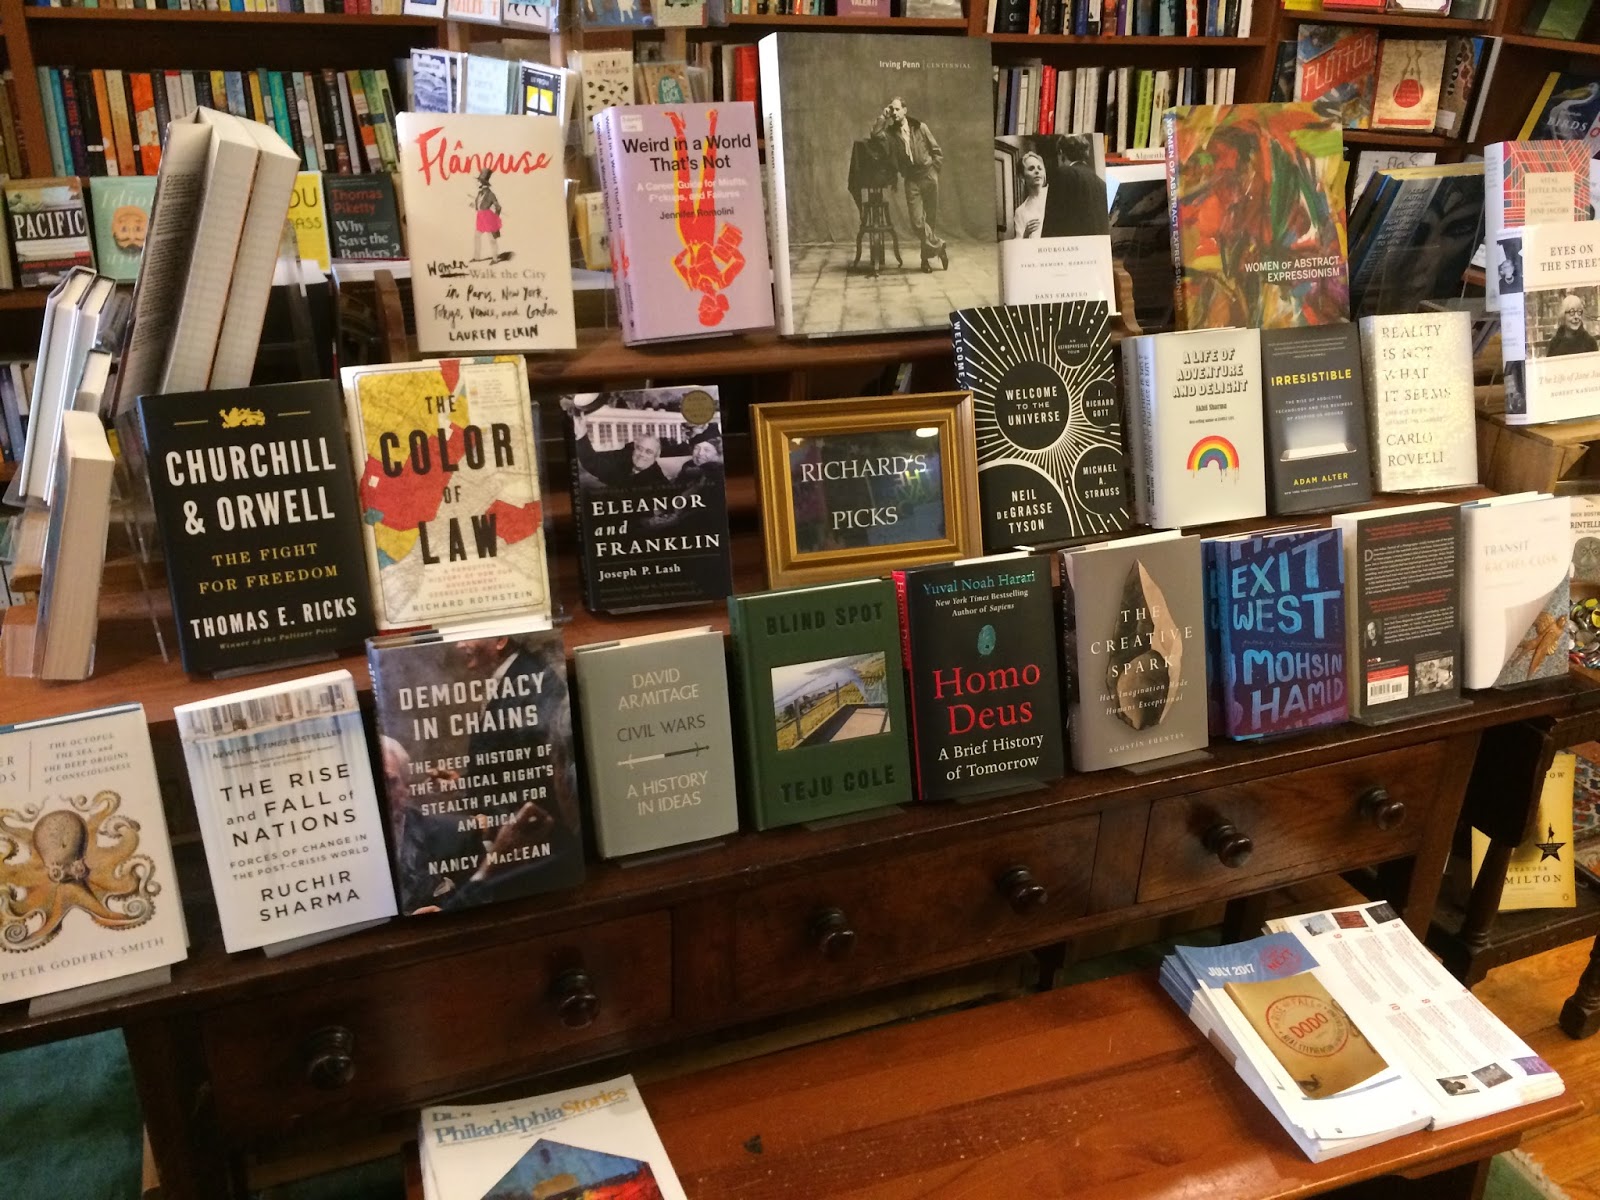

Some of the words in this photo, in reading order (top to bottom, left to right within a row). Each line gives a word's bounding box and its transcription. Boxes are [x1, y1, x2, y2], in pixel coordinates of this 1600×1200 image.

[879, 61, 900, 69] Irving
[903, 61, 920, 69] Penn
[662, 91, 680, 101] LUCK
[1547, 117, 1588, 131] BIRDS
[622, 138, 669, 153] Weird
[674, 137, 687, 150] in
[693, 141, 700, 150] a
[706, 134, 751, 149] World
[651, 157, 698, 172] That's
[703, 155, 731, 168] Not
[1169, 161, 1175, 175] OF
[332, 189, 383, 199] Thomas
[1169, 177, 1178, 228] ABSTRACT
[660, 211, 695, 219] Jennifer
[697, 207, 734, 216] Romolini
[13, 210, 85, 239] PACIFIC
[336, 221, 364, 235] Why
[339, 235, 367, 246] Save
[370, 233, 388, 244] the
[1551, 246, 1575, 256] EYES
[1580, 244, 1593, 254] ON
[1245, 259, 1279, 273] WOMEN
[1294, 256, 1340, 269] ABSTRACT
[1540, 261, 1561, 271] THE
[470, 270, 496, 279] Walk
[501, 270, 518, 279] the
[523, 269, 546, 280] City
[1267, 268, 1340, 283] EXPRESSIONISM
[450, 329, 496, 341] LAUREN
[505, 325, 538, 341] ELKIN
[1382, 325, 1442, 339] REALITY
[953, 321, 966, 378] WELCOME
[1383, 348, 1396, 360] IS
[1402, 346, 1433, 359] NOT
[1176, 364, 1243, 381] ADVENTURE
[1271, 369, 1351, 386] IRRESISTIBLE
[1006, 386, 1057, 400] WELCOME
[1173, 384, 1197, 398] AND
[1200, 380, 1248, 396] DELIGHT
[425, 395, 456, 414] THE
[1086, 399, 1114, 408] RICHARD
[1008, 411, 1060, 426] UNIVERSE
[1093, 409, 1109, 417] GOTT
[1387, 432, 1433, 446] CARLO
[379, 423, 515, 478] COLOR
[1388, 451, 1444, 467] ROVELLI
[165, 437, 336, 487] CHURCHILL
[1083, 464, 1117, 475] MICHAEL
[1294, 477, 1317, 486] ADAM
[1322, 473, 1348, 482] ALTER
[1012, 489, 1036, 502] NEIL
[1085, 487, 1120, 499] STRAUSS
[592, 494, 706, 516] ELEANOR
[595, 520, 628, 537] and
[1009, 521, 1045, 534] TYSON
[418, 513, 498, 565] LAW
[212, 551, 250, 567] THE
[260, 542, 318, 562] FIGHT
[1484, 540, 1529, 557] TRANSIT
[598, 568, 637, 582] Joseph
[642, 566, 651, 575] P.
[655, 564, 681, 574] Lash
[1232, 533, 1334, 599] EXIT
[199, 579, 237, 594] FOR
[246, 565, 338, 588] FREEDOM
[413, 599, 466, 612] RICHARD
[470, 590, 533, 605] ROTHSTEIN
[935, 599, 950, 607] New
[952, 596, 967, 605] York
[969, 594, 989, 602] Times
[991, 589, 1029, 600] Bestselling
[952, 607, 977, 617] Author
[979, 605, 987, 613] of
[989, 602, 1014, 612] Sapiens
[1121, 606, 1160, 623] THE
[1232, 590, 1341, 639] WEST
[766, 610, 826, 636] BLIND
[835, 602, 883, 626] SPOT
[220, 641, 249, 649] Winner
[280, 632, 313, 640] Pulitzer
[316, 627, 336, 635] Prize
[632, 668, 681, 689] DAVID
[932, 664, 1041, 699] Homo
[399, 672, 545, 710] DEMOCRACY
[618, 684, 699, 712] ARMITAGE
[1106, 703, 1135, 715] Humans
[1139, 693, 1183, 709] Exceptional
[413, 718, 438, 741] IN
[450, 705, 539, 736] CHAINS
[948, 702, 1033, 735] Deus
[617, 724, 655, 742] CIVIL
[660, 715, 706, 734] WARS
[938, 748, 949, 761] A
[954, 740, 989, 759] Brief
[993, 734, 1044, 752] History
[44, 763, 61, 773] THE
[65, 760, 87, 769] DEEP
[91, 752, 128, 764] ORIGINS
[946, 767, 961, 781] of
[966, 755, 1039, 777] Tomorrow
[626, 784, 639, 799] A
[643, 771, 709, 796] HISTORY
[780, 775, 833, 803] TEJU
[843, 765, 896, 792] COLE
[226, 811, 256, 826] and
[264, 791, 331, 817] FALL
[339, 791, 354, 802] of
[421, 796, 478, 816] STEALTH
[484, 792, 517, 808] PLAN
[523, 787, 547, 800] FOR
[638, 801, 654, 816] IN
[659, 791, 701, 812] IDEAS
[229, 853, 278, 869] FORCES
[283, 848, 298, 858] OF
[302, 837, 350, 853] CHANGE
[355, 834, 367, 842] IN
[233, 871, 254, 881] THE
[258, 854, 327, 876] POST-CRISIS
[330, 846, 369, 859] WORLD
[428, 855, 479, 875] NANCY
[1505, 875, 1562, 884] MILTON
[2, 964, 46, 982] PETER
[50, 936, 165, 971] GODFREY-SMITH
[1208, 967, 1231, 976] JULY
[1232, 963, 1255, 976] 2017
